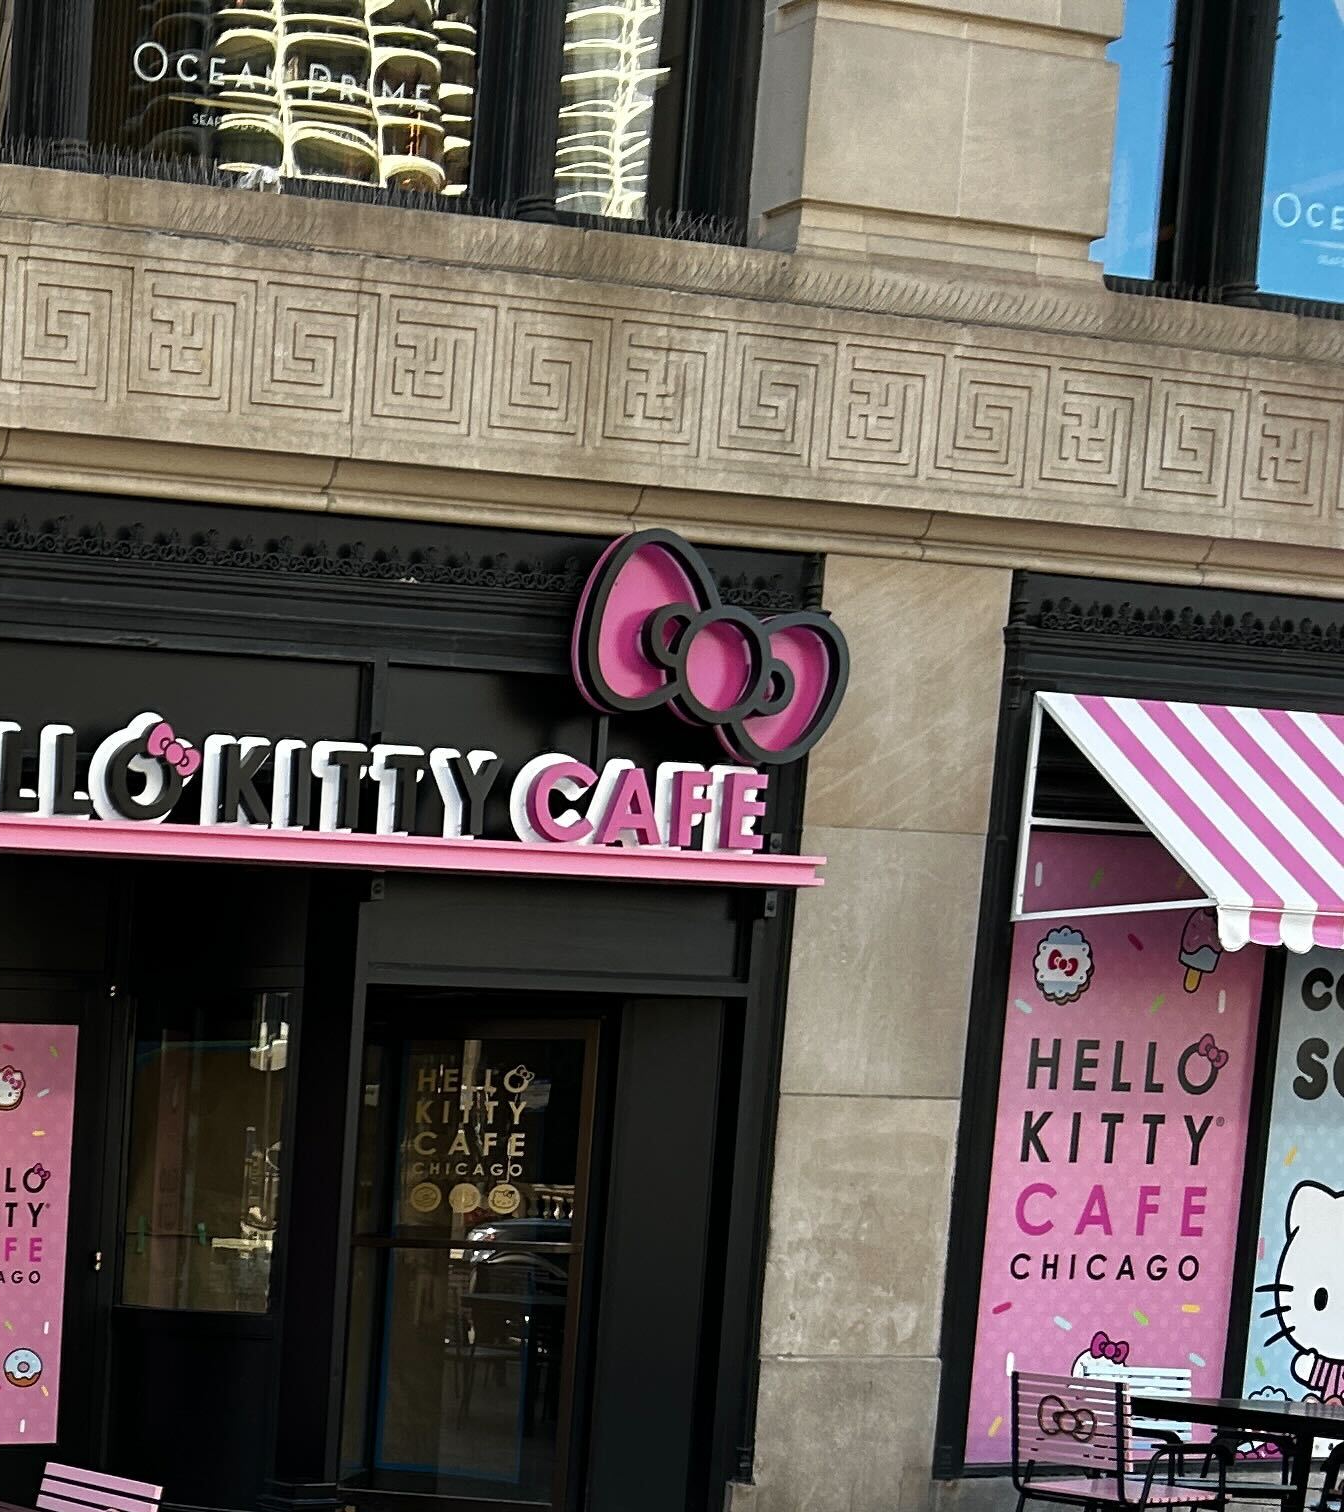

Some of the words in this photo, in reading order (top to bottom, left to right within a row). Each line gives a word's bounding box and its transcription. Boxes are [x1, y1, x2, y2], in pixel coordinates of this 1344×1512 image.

[199, 735, 504, 841] KITTY
[510, 753, 768, 854] CAFE
[1301, 967, 1344, 1011] C
[417, 1067, 531, 1093] HELLO
[1026, 1035, 1222, 1095] HELLO
[1293, 1037, 1344, 1101] S
[415, 1101, 527, 1124] KITTY
[413, 1131, 526, 1156] CAFE
[413, 1162, 523, 1177] CHICAGO
[1015, 1183, 1207, 1237] CAFE
[1010, 1253, 1200, 1282] CHICAGO
